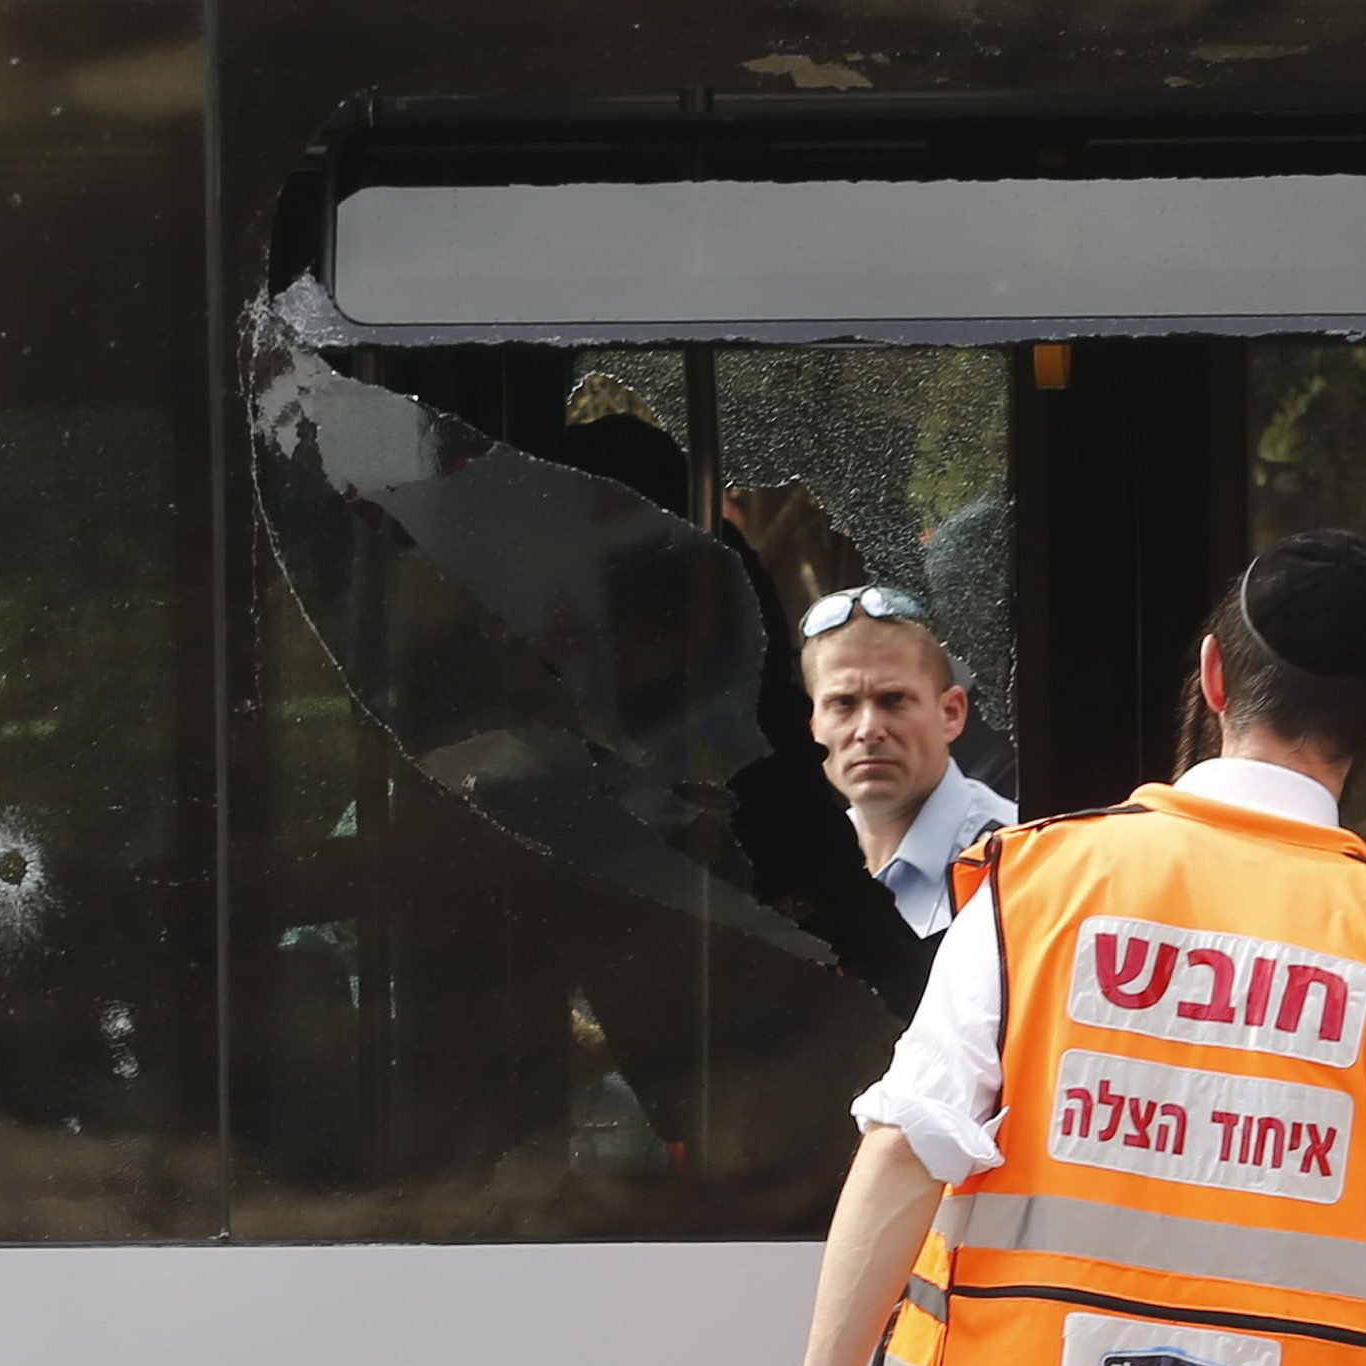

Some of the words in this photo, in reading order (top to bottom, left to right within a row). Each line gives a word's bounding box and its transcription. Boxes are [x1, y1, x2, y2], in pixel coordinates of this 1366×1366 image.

[1093, 931, 1352, 1042] חובש
[1060, 1080, 1189, 1155] הצלה
[1211, 1108, 1339, 1178] איחוד
